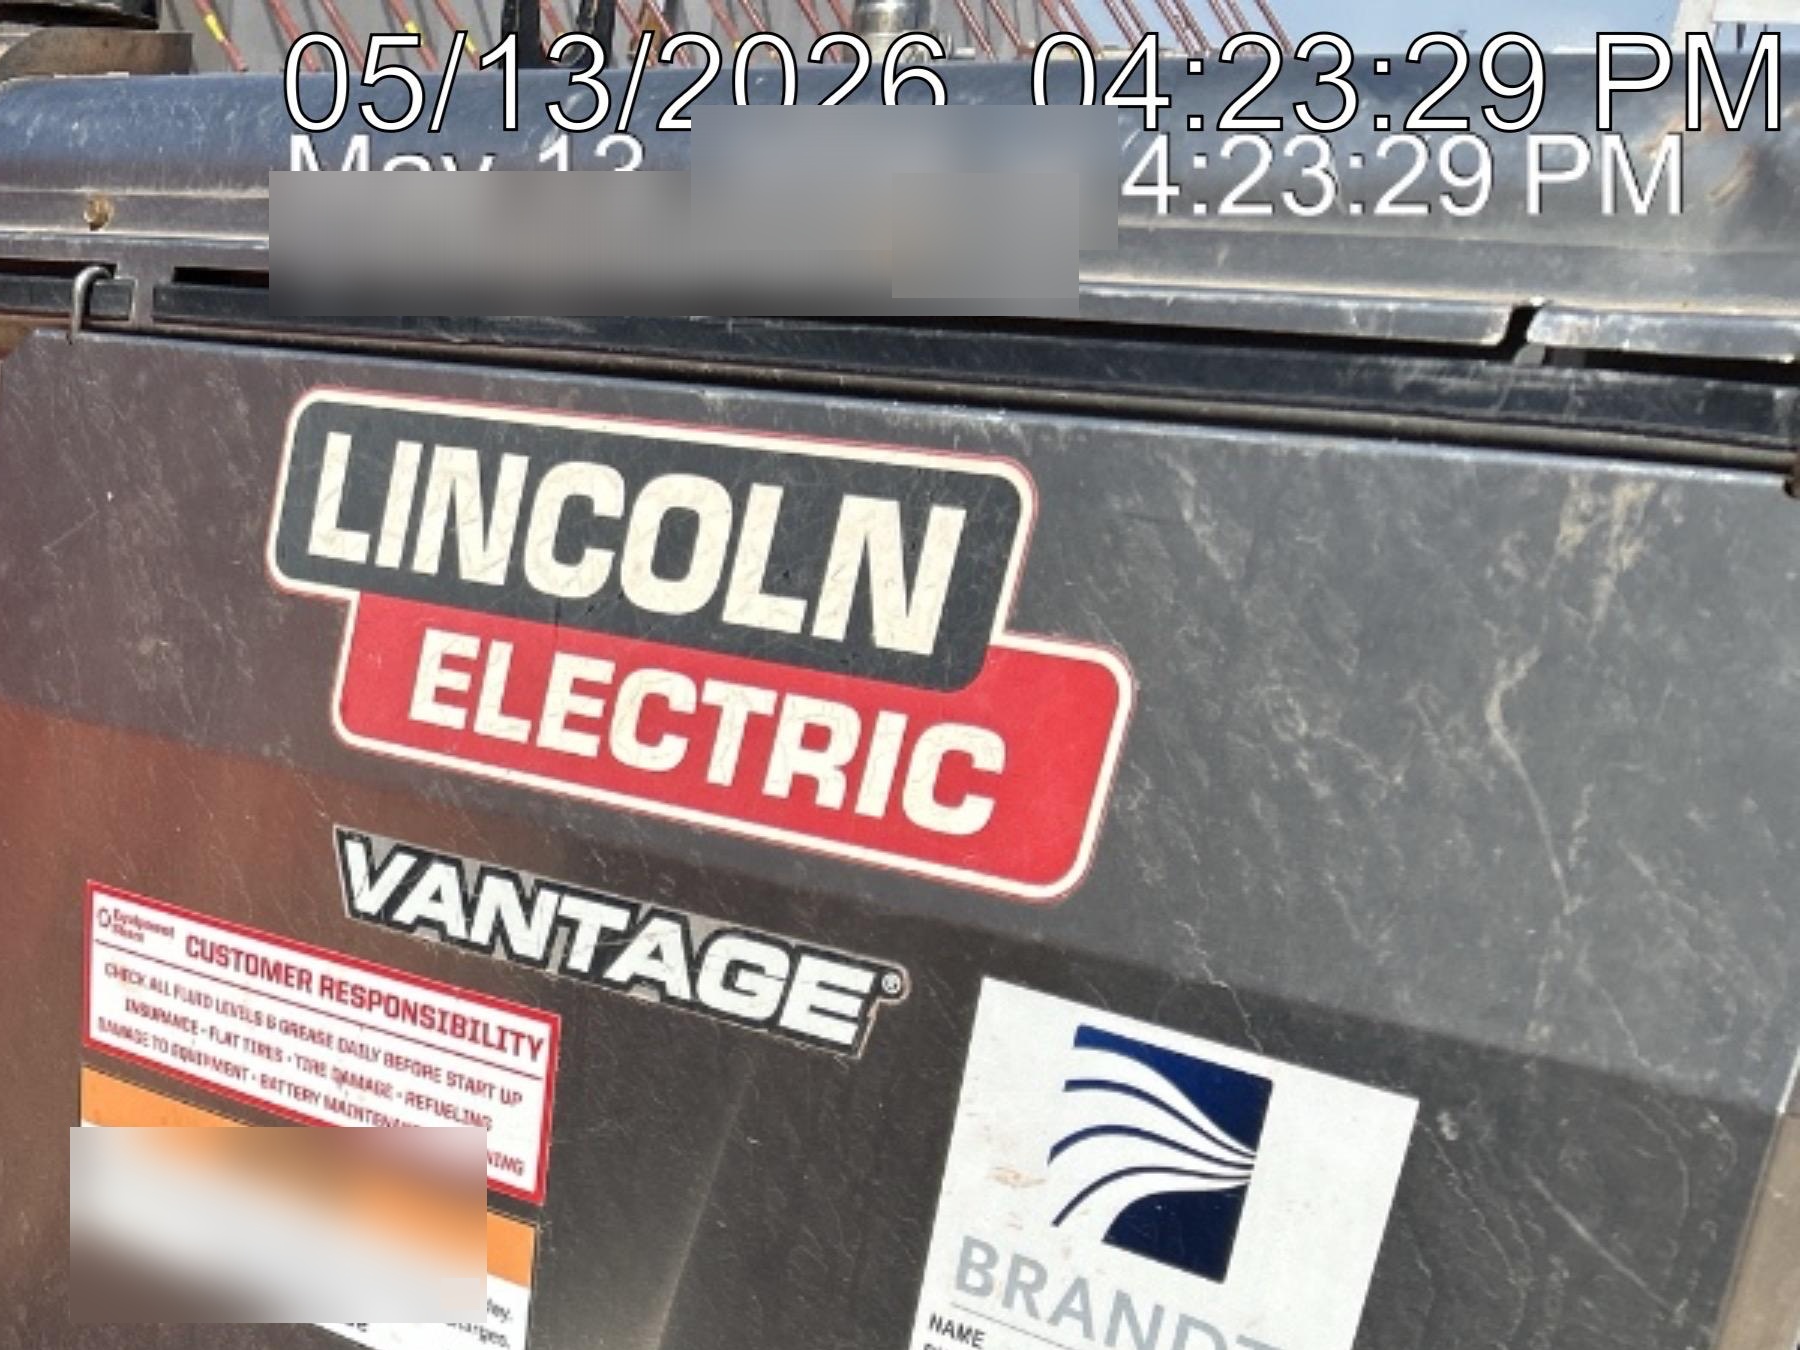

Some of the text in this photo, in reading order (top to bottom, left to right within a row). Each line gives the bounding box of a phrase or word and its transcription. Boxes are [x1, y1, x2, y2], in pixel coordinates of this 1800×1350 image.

[307, 430, 967, 655] LINCOLN
[408, 628, 1007, 837] ELECTRIC
[104, 962, 147, 986] CHECK
[149, 976, 172, 997] ALL
[173, 983, 214, 1010] FLUID
[215, 998, 264, 1028] LEVELS
[279, 1019, 334, 1050] GREASE
[337, 1036, 382, 1063] DAILY
[383, 1051, 442, 1084] BEFORE
[446, 1070, 497, 1100] START
[500, 1088, 523, 1107] UP
[125, 997, 492, 1132] INSURANCE FLAT TIRES TIRE DAMAGE REFUELING
[185, 934, 545, 1062] CUSTOMER RESPONSIBILITY
[151, 1034, 169, 1053] TO
[170, 1043, 249, 1081] EQUIPMENT
[260, 1073, 321, 1107] BATTERY
[928, 1312, 986, 1350] NAME
